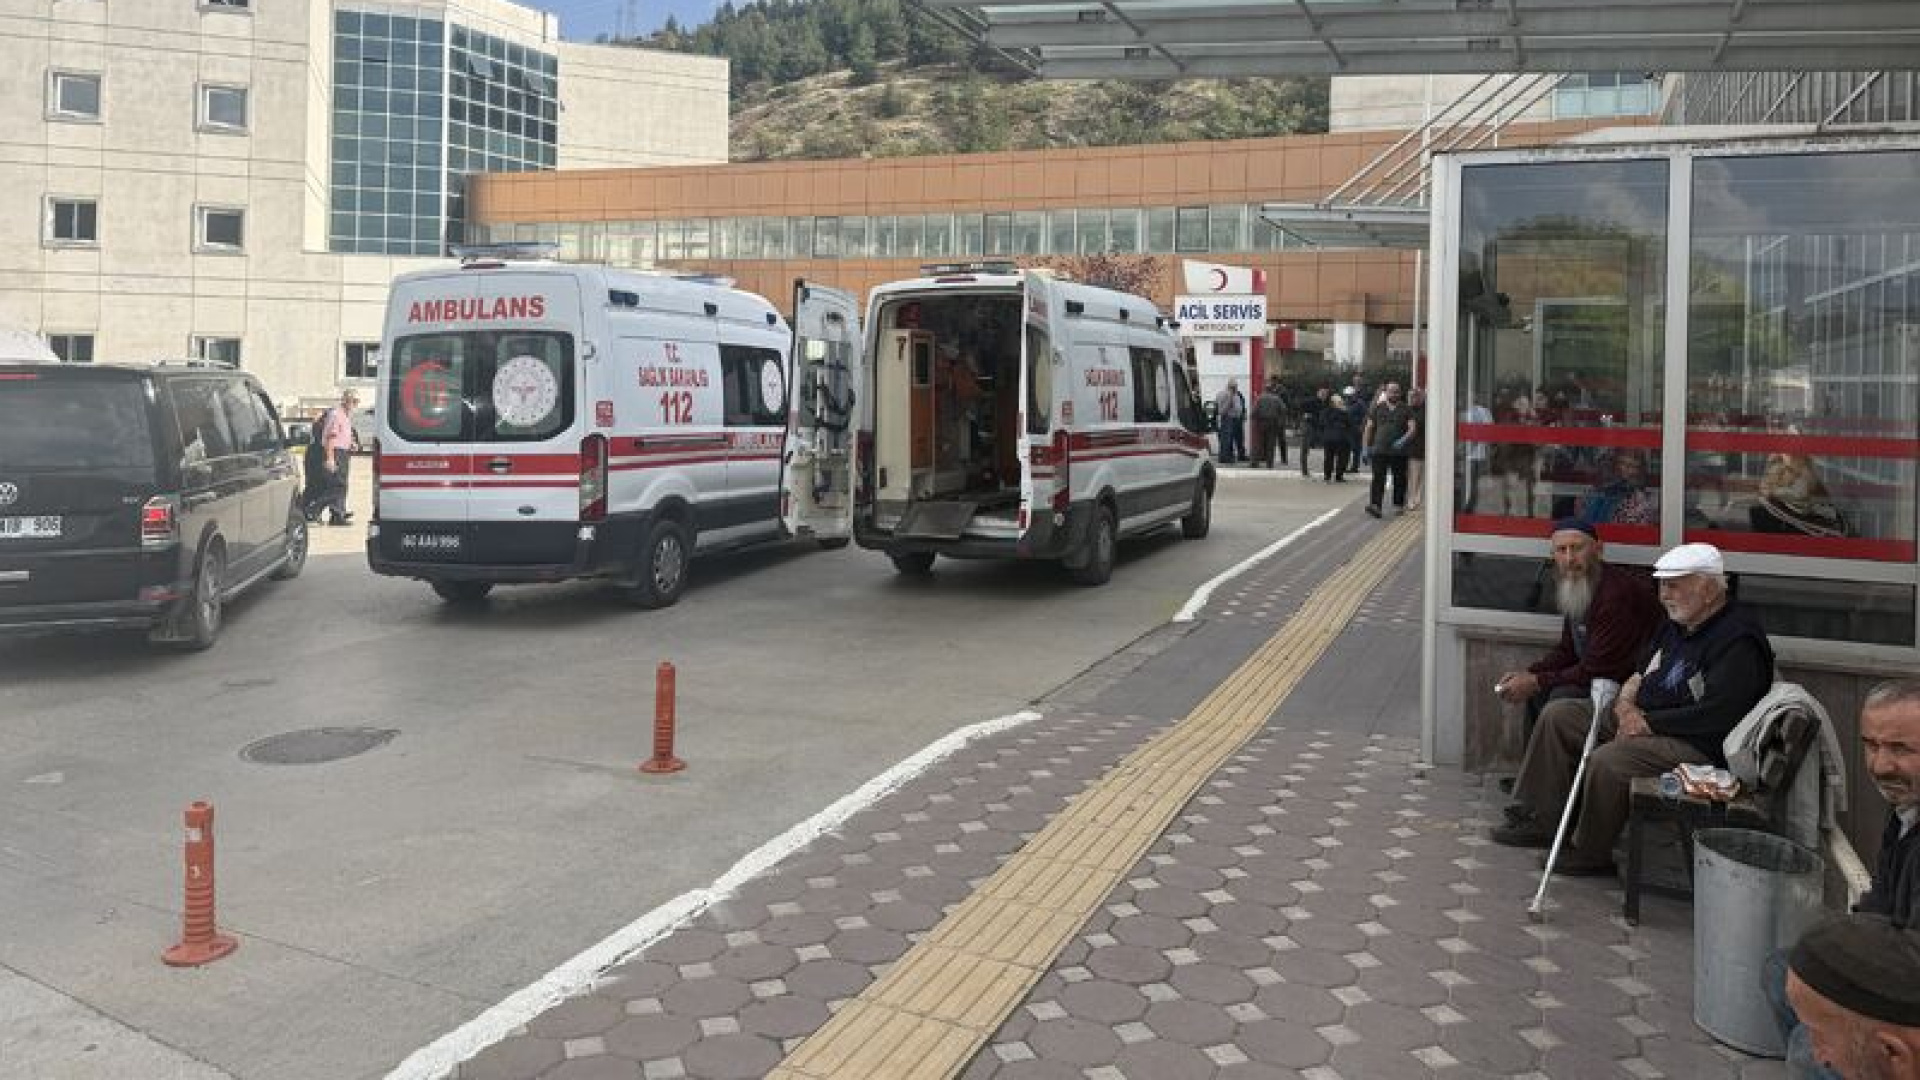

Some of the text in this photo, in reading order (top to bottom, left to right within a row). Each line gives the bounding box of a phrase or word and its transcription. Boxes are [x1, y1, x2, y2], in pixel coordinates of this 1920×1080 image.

[408, 295, 544, 323] AMBULANS
[1179, 300, 1262, 320] ACİL SERVİS
[1194, 324, 1245, 332] EMERGENCY
[660, 391, 693, 424] 112
[1098, 391, 1118, 421] 112
